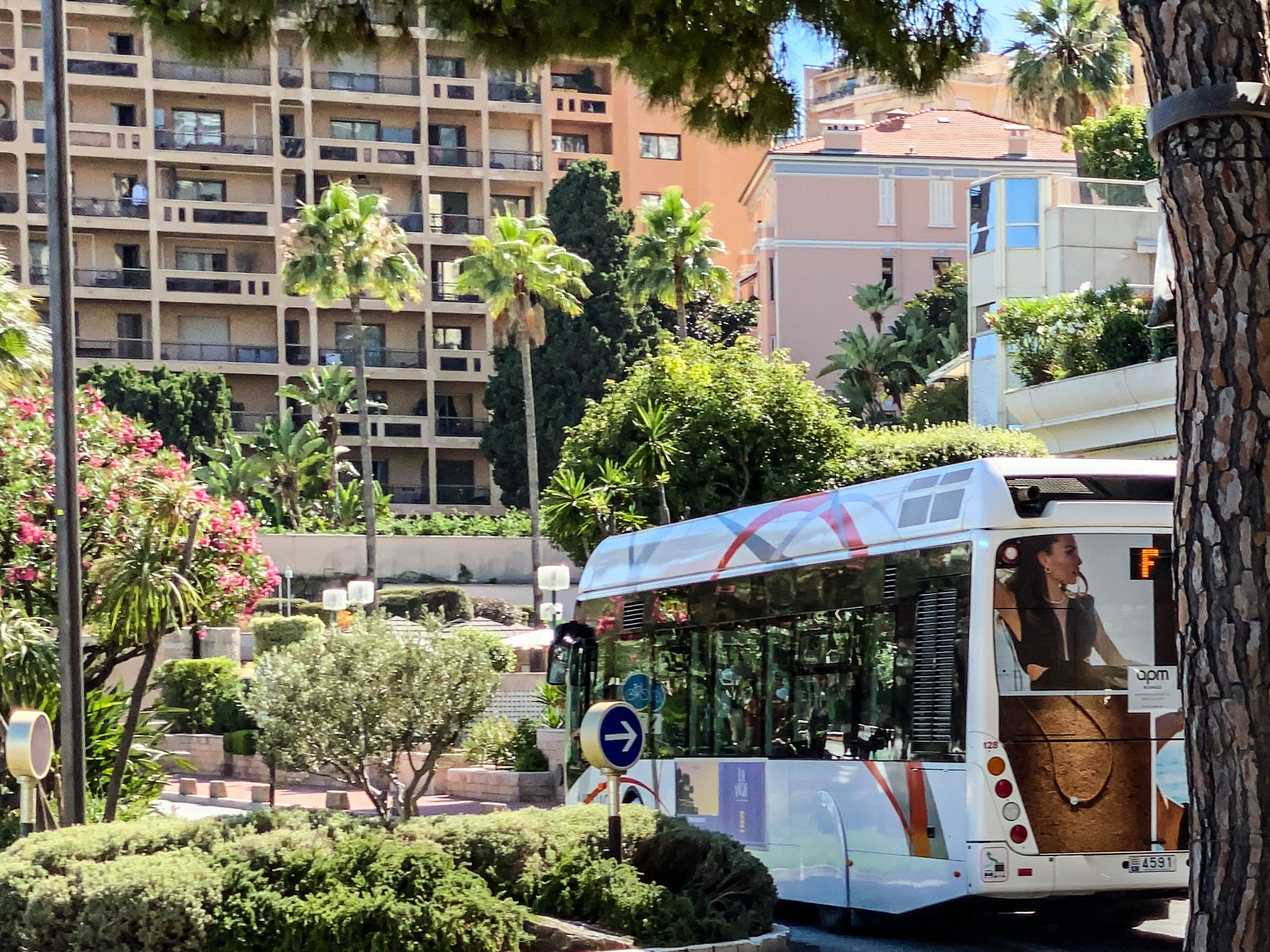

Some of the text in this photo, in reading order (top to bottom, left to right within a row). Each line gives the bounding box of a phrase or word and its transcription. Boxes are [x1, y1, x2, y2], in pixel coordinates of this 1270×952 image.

[1142, 548, 1159, 578] F
[1136, 669, 1170, 685] apm
[1142, 856, 1172, 869] 4591
